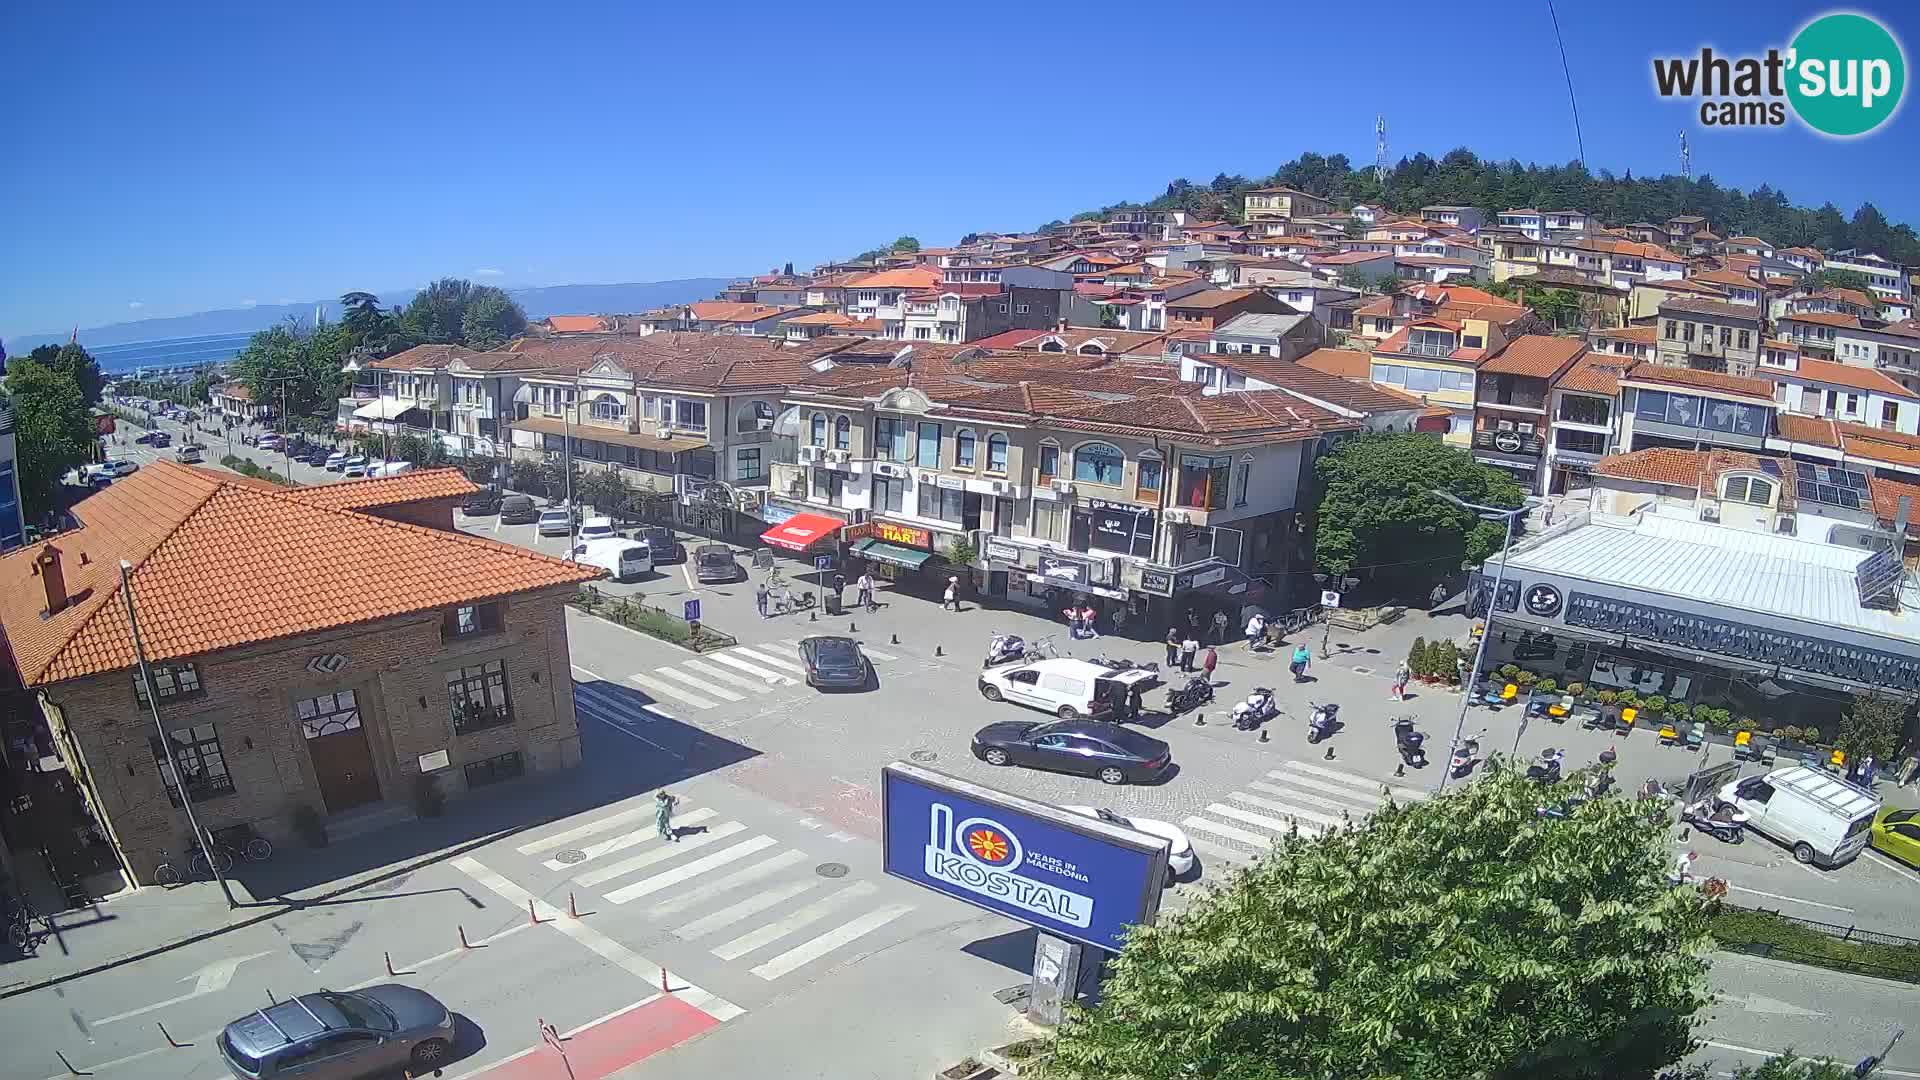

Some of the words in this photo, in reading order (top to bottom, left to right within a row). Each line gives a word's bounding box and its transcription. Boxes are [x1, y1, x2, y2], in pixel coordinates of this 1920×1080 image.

[883, 528, 916, 545] HARI
[1026, 857, 1090, 883] MACEDONIA
[1027, 850, 1064, 868] YEARS
[1065, 862, 1077, 872] IN
[935, 853, 1080, 921] KOSTAL
